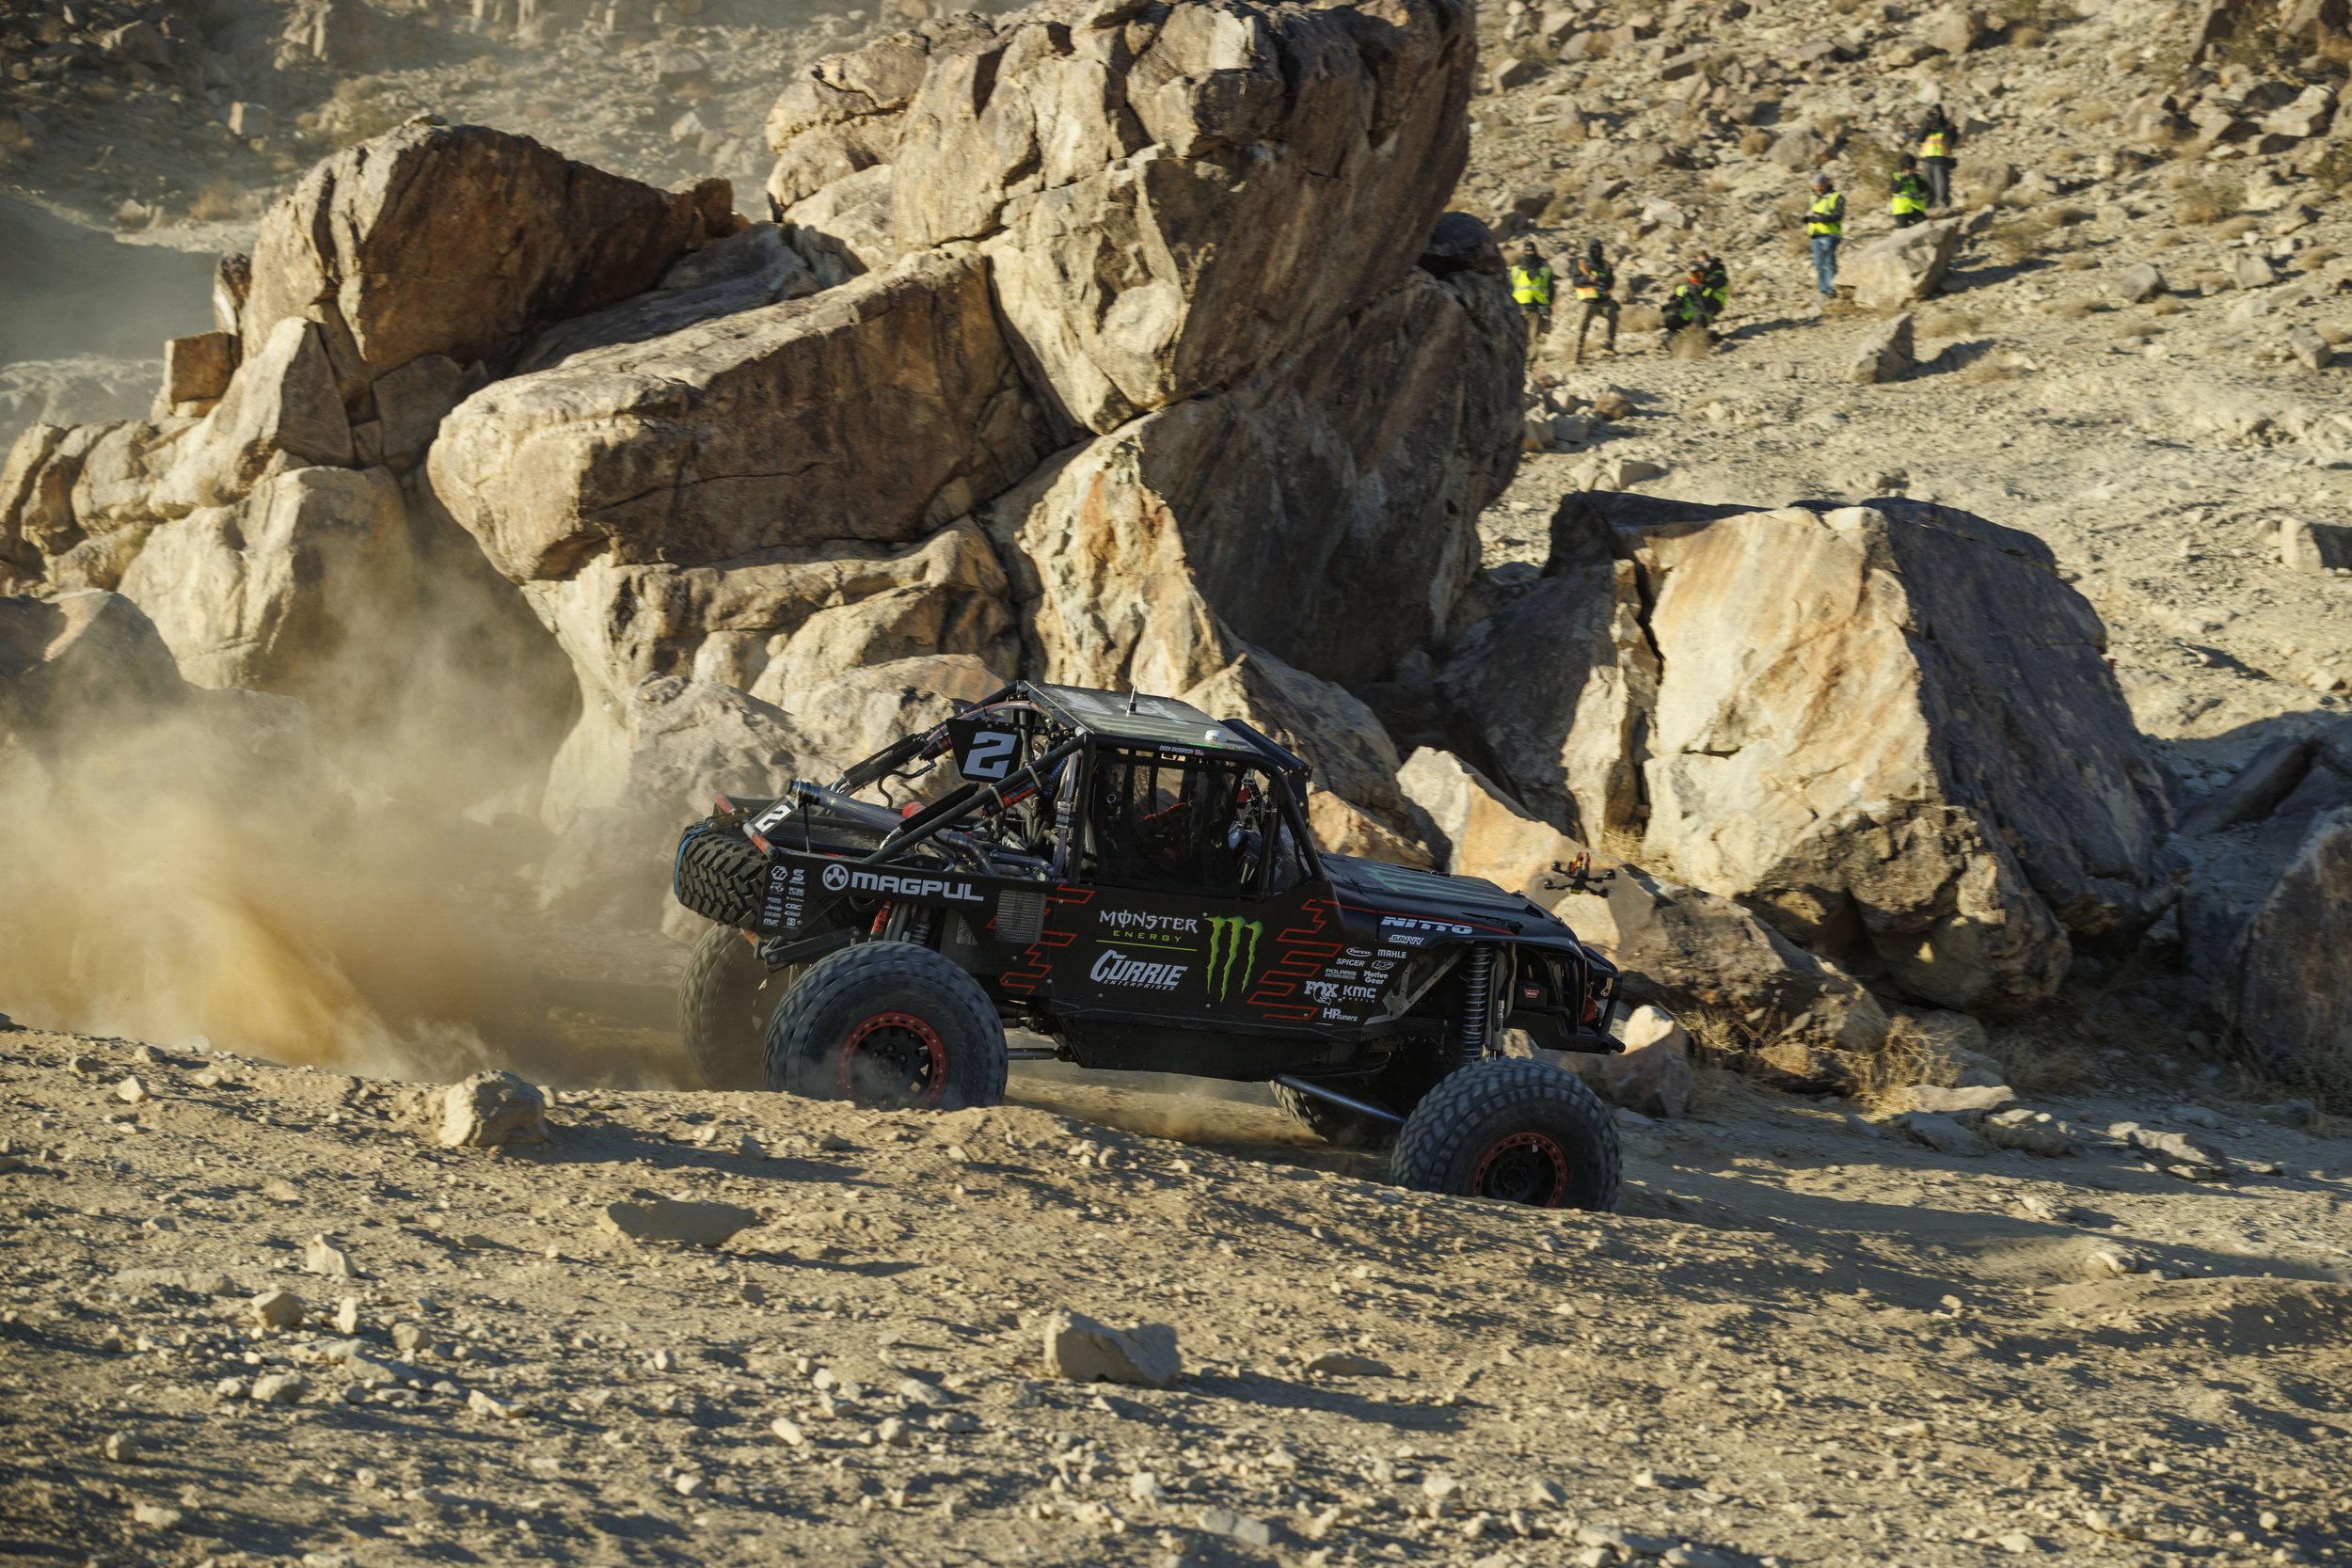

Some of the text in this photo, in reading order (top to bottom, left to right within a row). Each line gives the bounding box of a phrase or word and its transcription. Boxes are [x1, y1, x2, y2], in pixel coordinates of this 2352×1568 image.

[962, 731, 1017, 779] 2
[755, 803, 795, 832] 2
[850, 871, 984, 901] MAGPUL
[1099, 909, 1199, 934] MONSTER
[1381, 916, 1473, 934] NITTO
[1113, 929, 1182, 942] ENERGY
[1388, 934, 1424, 945] SAVVY
[1377, 948, 1407, 958] MAHLE
[1089, 949, 1188, 987] CURRIE
[1336, 958, 1365, 967] SPICER
[1325, 968, 1357, 976] POLARIS
[1363, 970, 1389, 979] Motive
[1103, 979, 1175, 991] ENTERPRISES
[1304, 980, 1339, 1000] FOX
[1343, 985, 1377, 998] KMC
